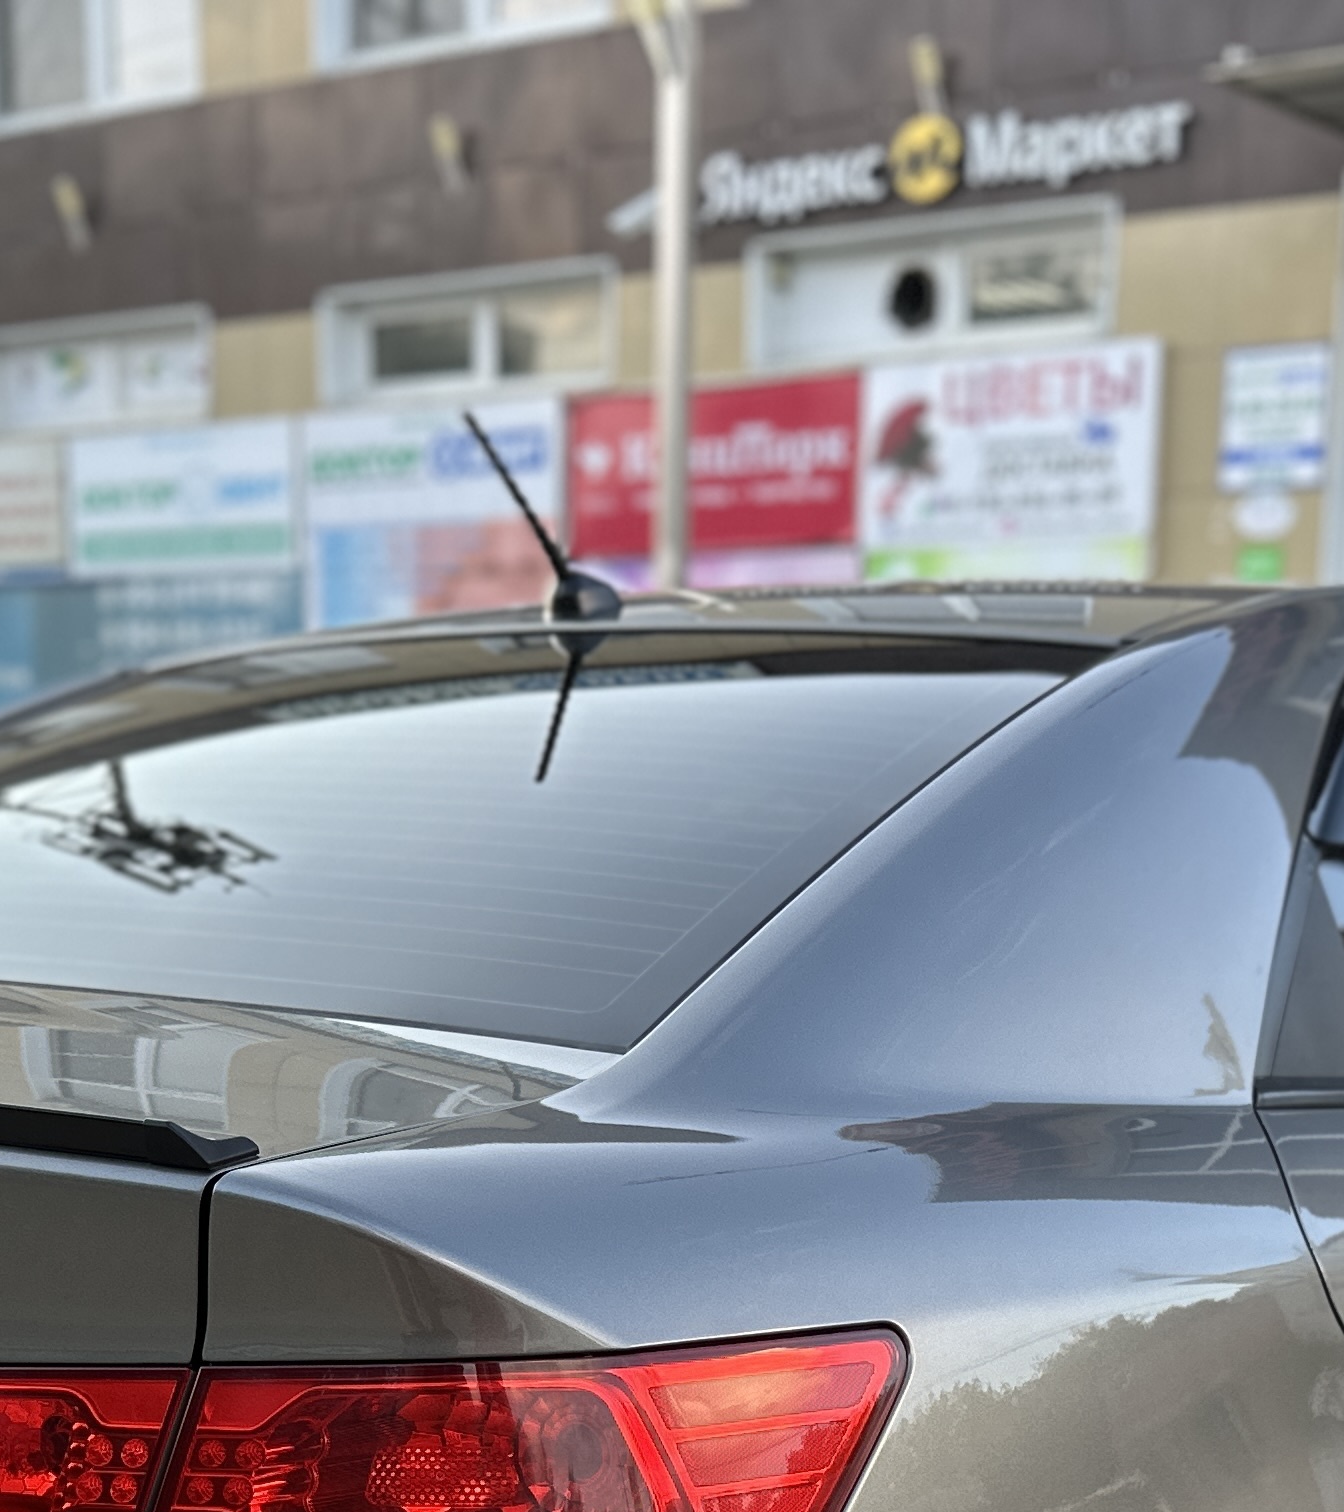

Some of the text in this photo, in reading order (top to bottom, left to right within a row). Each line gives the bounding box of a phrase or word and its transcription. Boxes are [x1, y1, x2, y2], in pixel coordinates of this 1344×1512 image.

[700, 102, 1193, 224] Яндекс Маркет
[941, 353, 1145, 427] ЦВЕТЫ
